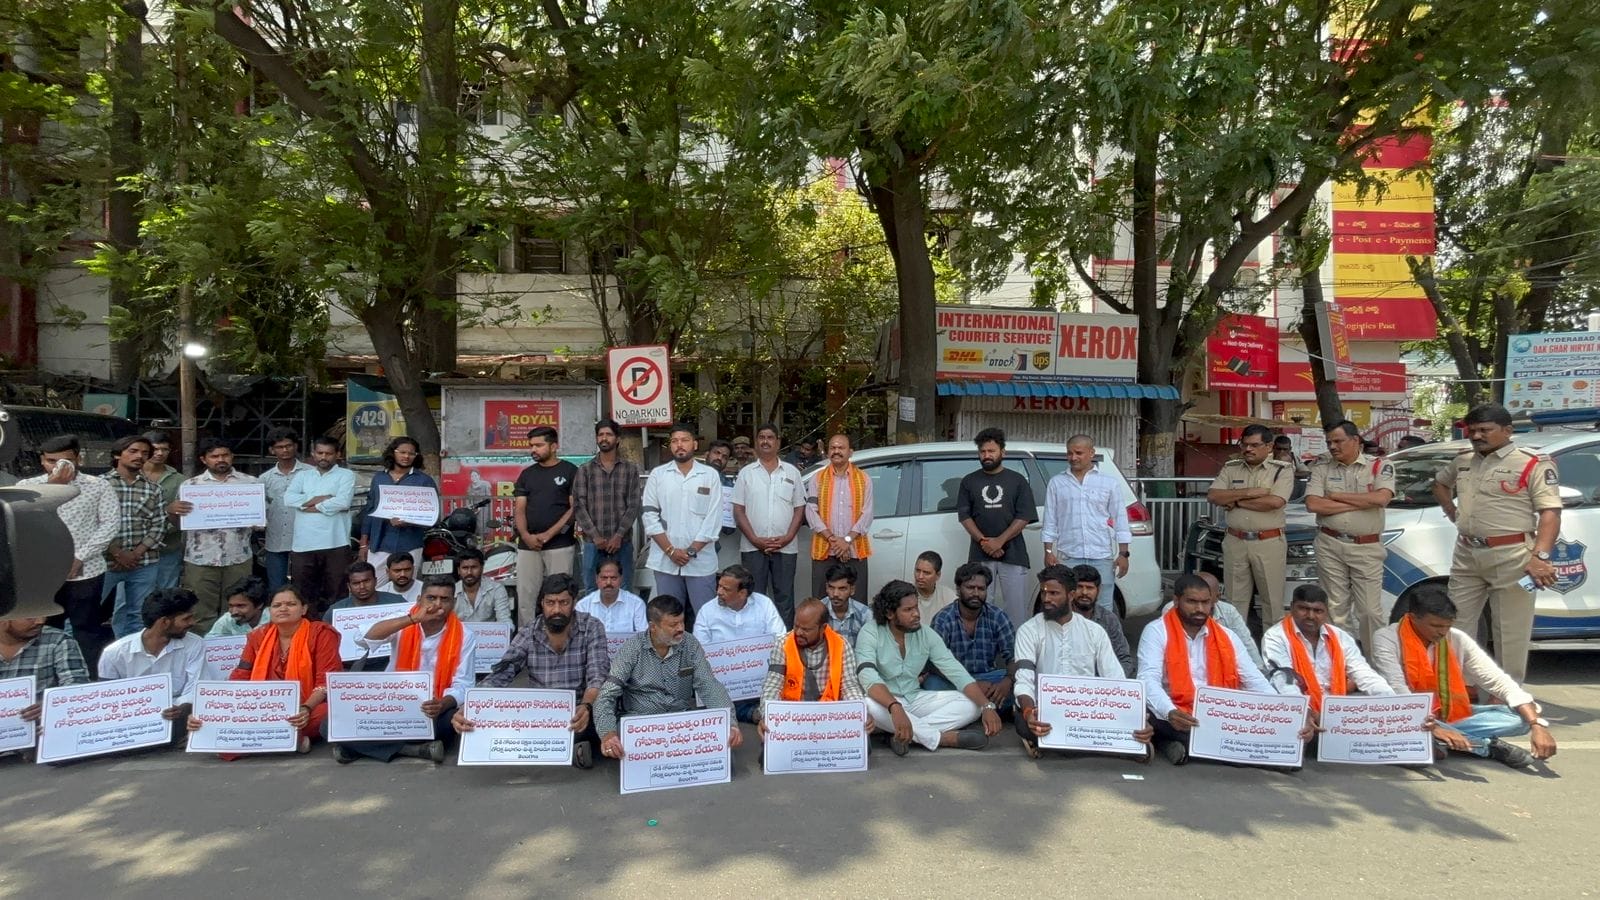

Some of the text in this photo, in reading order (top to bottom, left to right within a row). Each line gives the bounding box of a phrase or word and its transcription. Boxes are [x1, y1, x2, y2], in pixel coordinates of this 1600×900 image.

[1390, 237, 1431, 245] Payments
[938, 312, 1056, 331] INTERNATIONAL
[1345, 322, 1376, 331] ogistics
[949, 330, 1052, 345] COURIER SERVICE
[1059, 325, 1137, 360] XEROX
[1544, 335, 1595, 343] HYDERABAD
[949, 351, 977, 361] DHL
[1014, 395, 1091, 411] XEROX
[615, 407, 667, 419] NO PARKING
[510, 415, 557, 425] ROYAL
[127, 687, 138, 695] 10
[270, 688, 293, 697] 1977
[1391, 703, 1400, 711] 10
[701, 716, 724, 727] 1977
